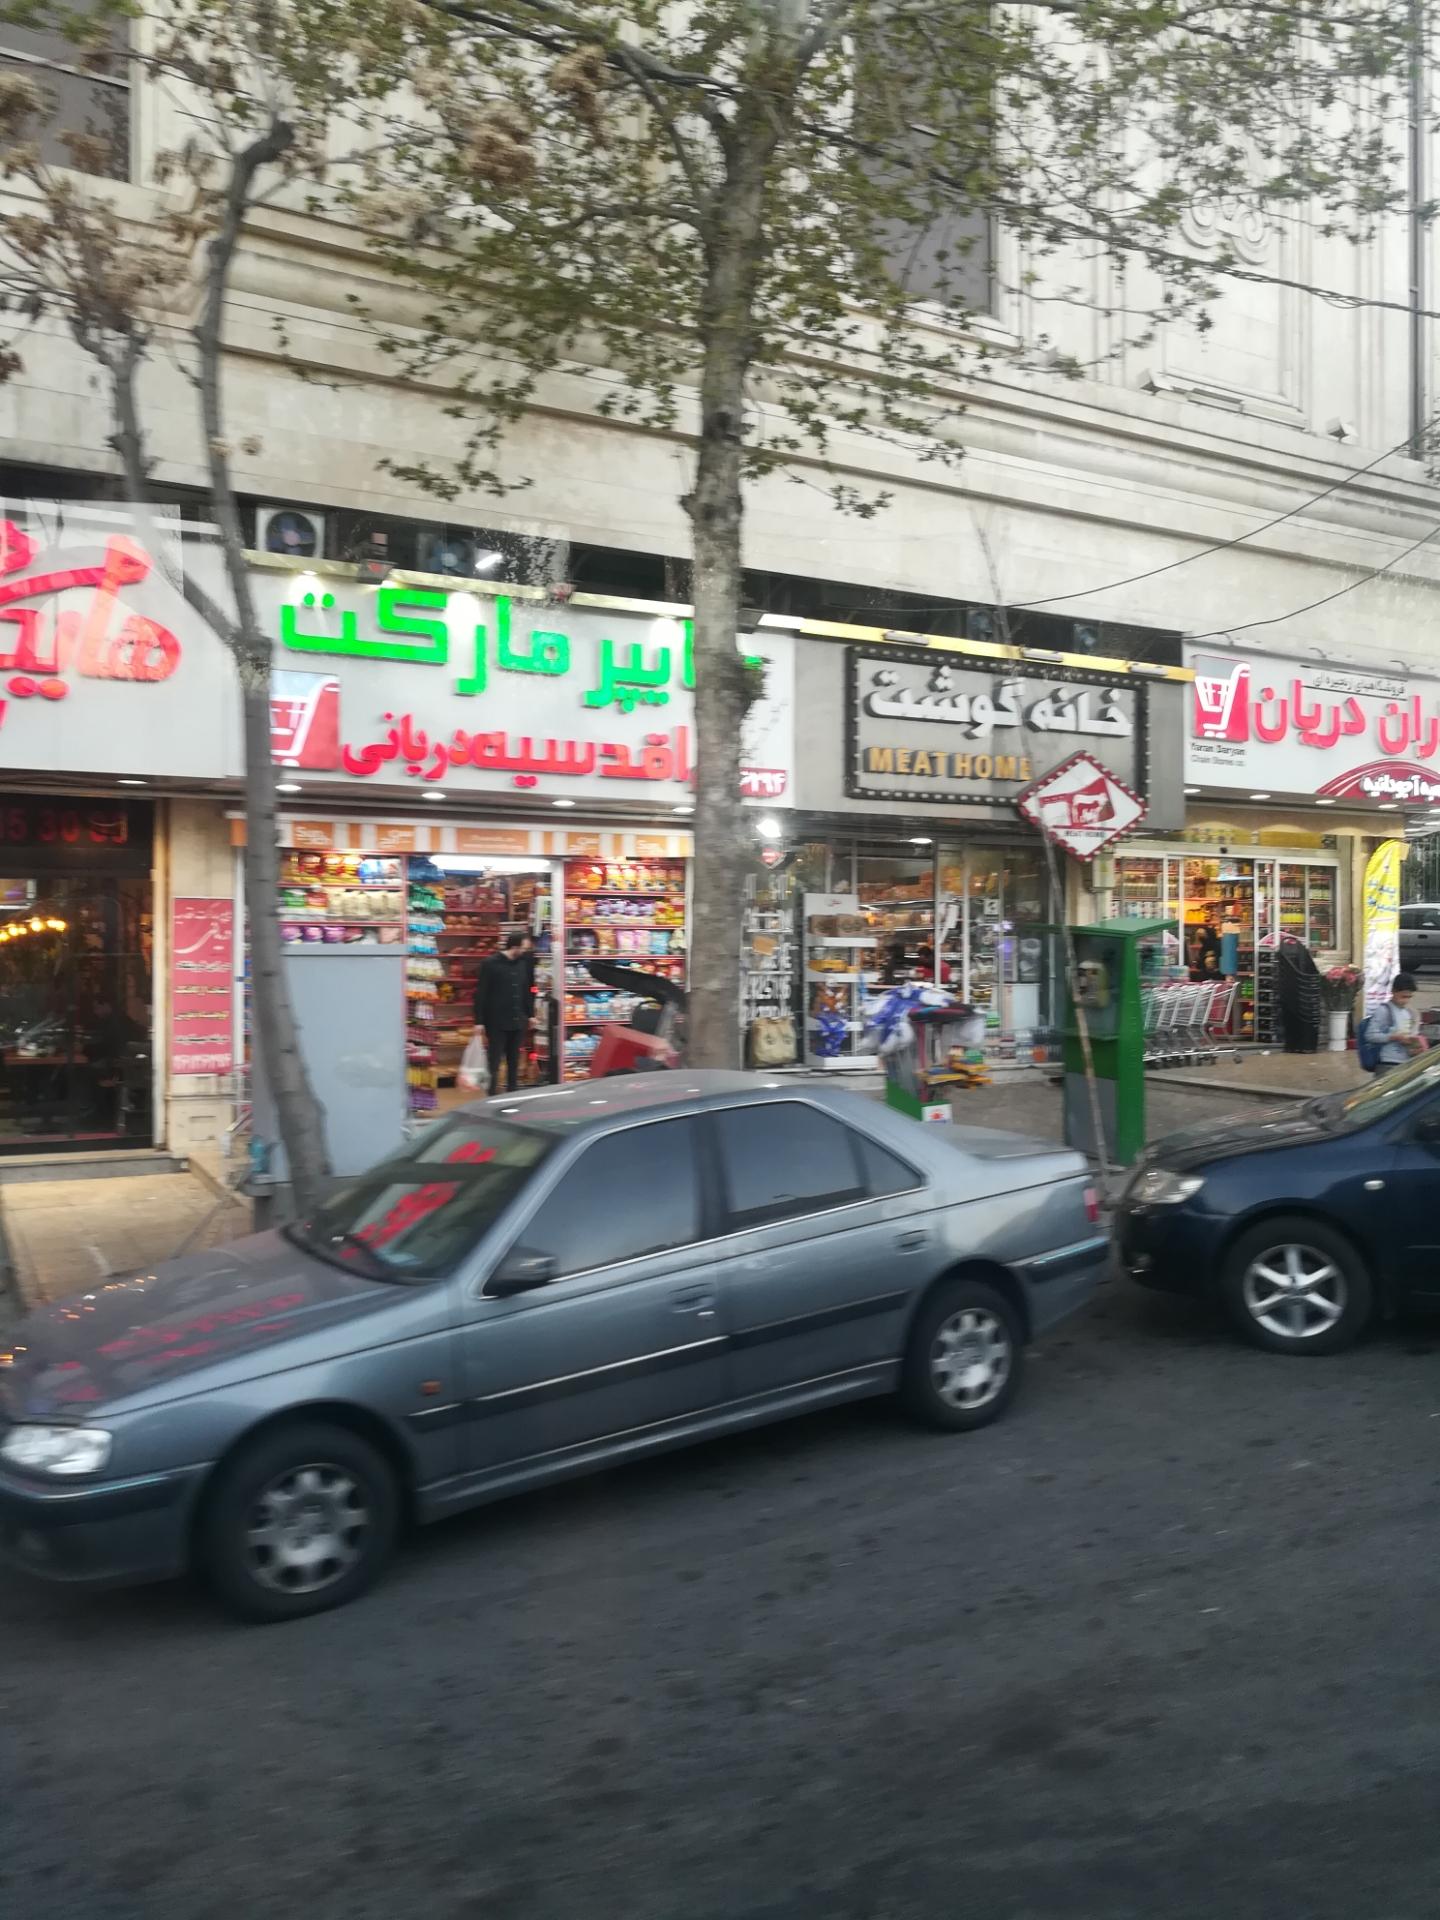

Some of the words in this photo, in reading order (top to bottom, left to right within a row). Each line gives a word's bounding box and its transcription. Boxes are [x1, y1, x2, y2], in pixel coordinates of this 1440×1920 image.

[281, 586, 571, 696] مارکت
[584, 619, 763, 713] ایپر
[864, 665, 1026, 739] گوشت
[1027, 687, 1133, 737] خانه
[1378, 694, 1440, 759] ران
[473, 725, 690, 788] اقدسیه
[866, 746, 947, 777] MEAT
[951, 751, 1032, 782] HOME
